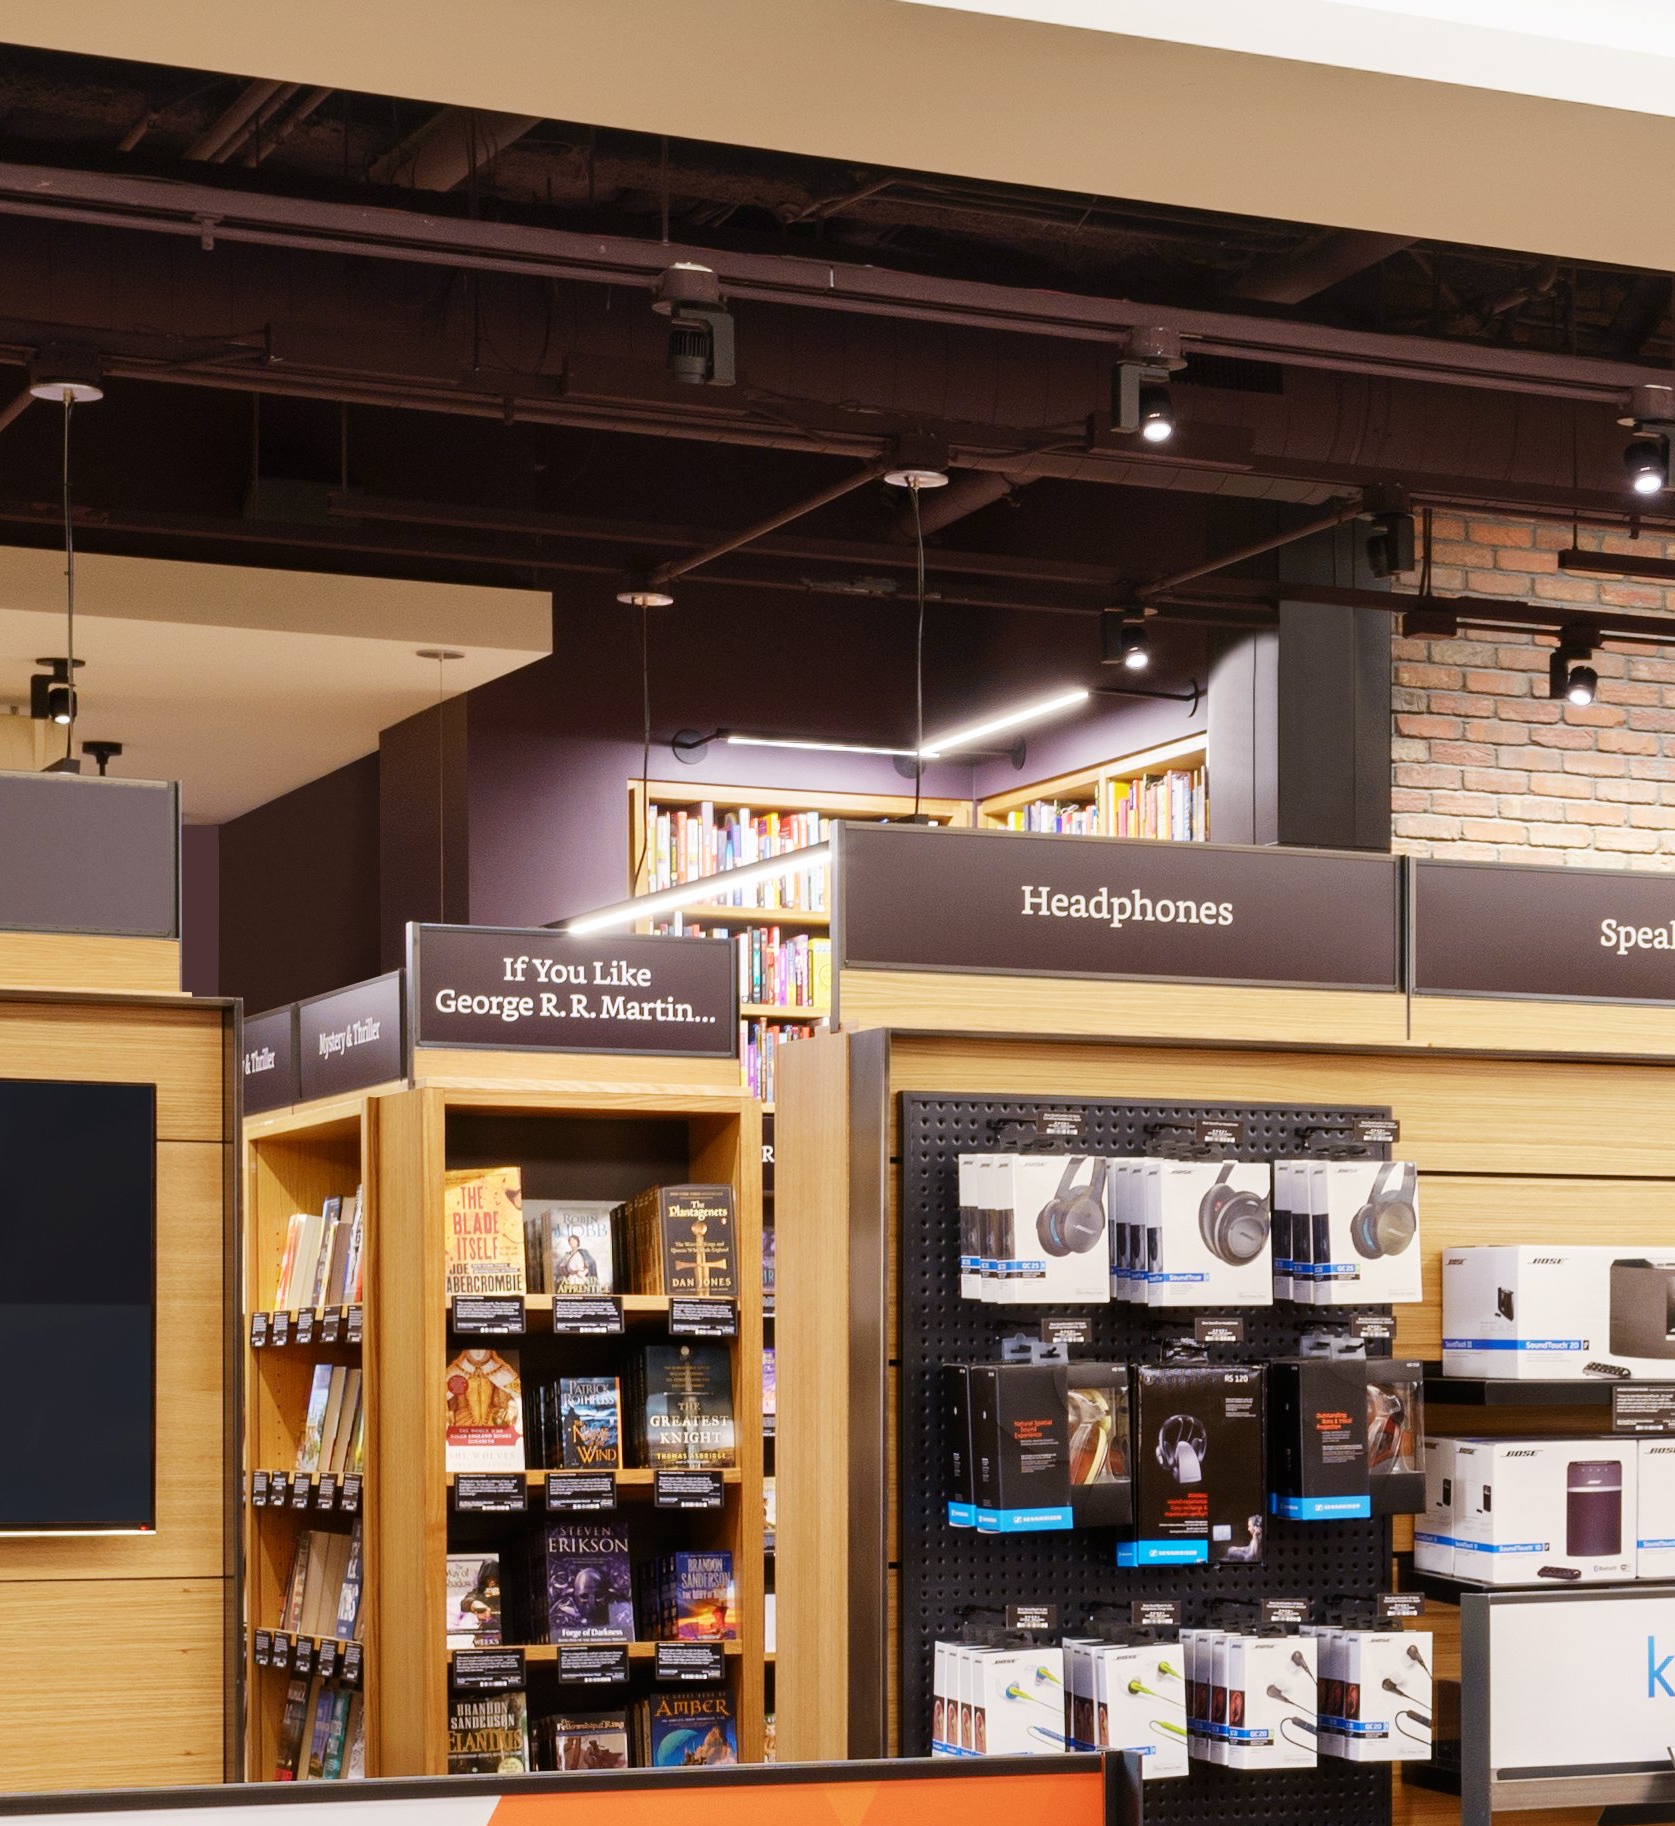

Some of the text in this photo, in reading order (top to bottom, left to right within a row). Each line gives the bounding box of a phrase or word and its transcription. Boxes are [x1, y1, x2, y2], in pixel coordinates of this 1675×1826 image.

[1021, 884, 1234, 929] Headphones
[503, 957, 651, 987] If You Like
[435, 989, 716, 1024] George R. R. Martin...
[319, 1017, 381, 1059] Mystery & Thriller
[460, 1187, 482, 1208] THE
[453, 1211, 499, 1234] BLADE
[457, 1238, 497, 1260] ITSELF
[447, 1275, 522, 1293] ABERCROMBIE
[650, 1416, 728, 1427] GREATEST
[660, 1432, 721, 1443] KNIGHT
[561, 1526, 611, 1536] STEVEN
[549, 1538, 628, 1552] ERIKSON
[456, 1703, 507, 1716] BRANDON
[655, 1700, 729, 1716] AMBER
[451, 1715, 514, 1729] SANDERSON
